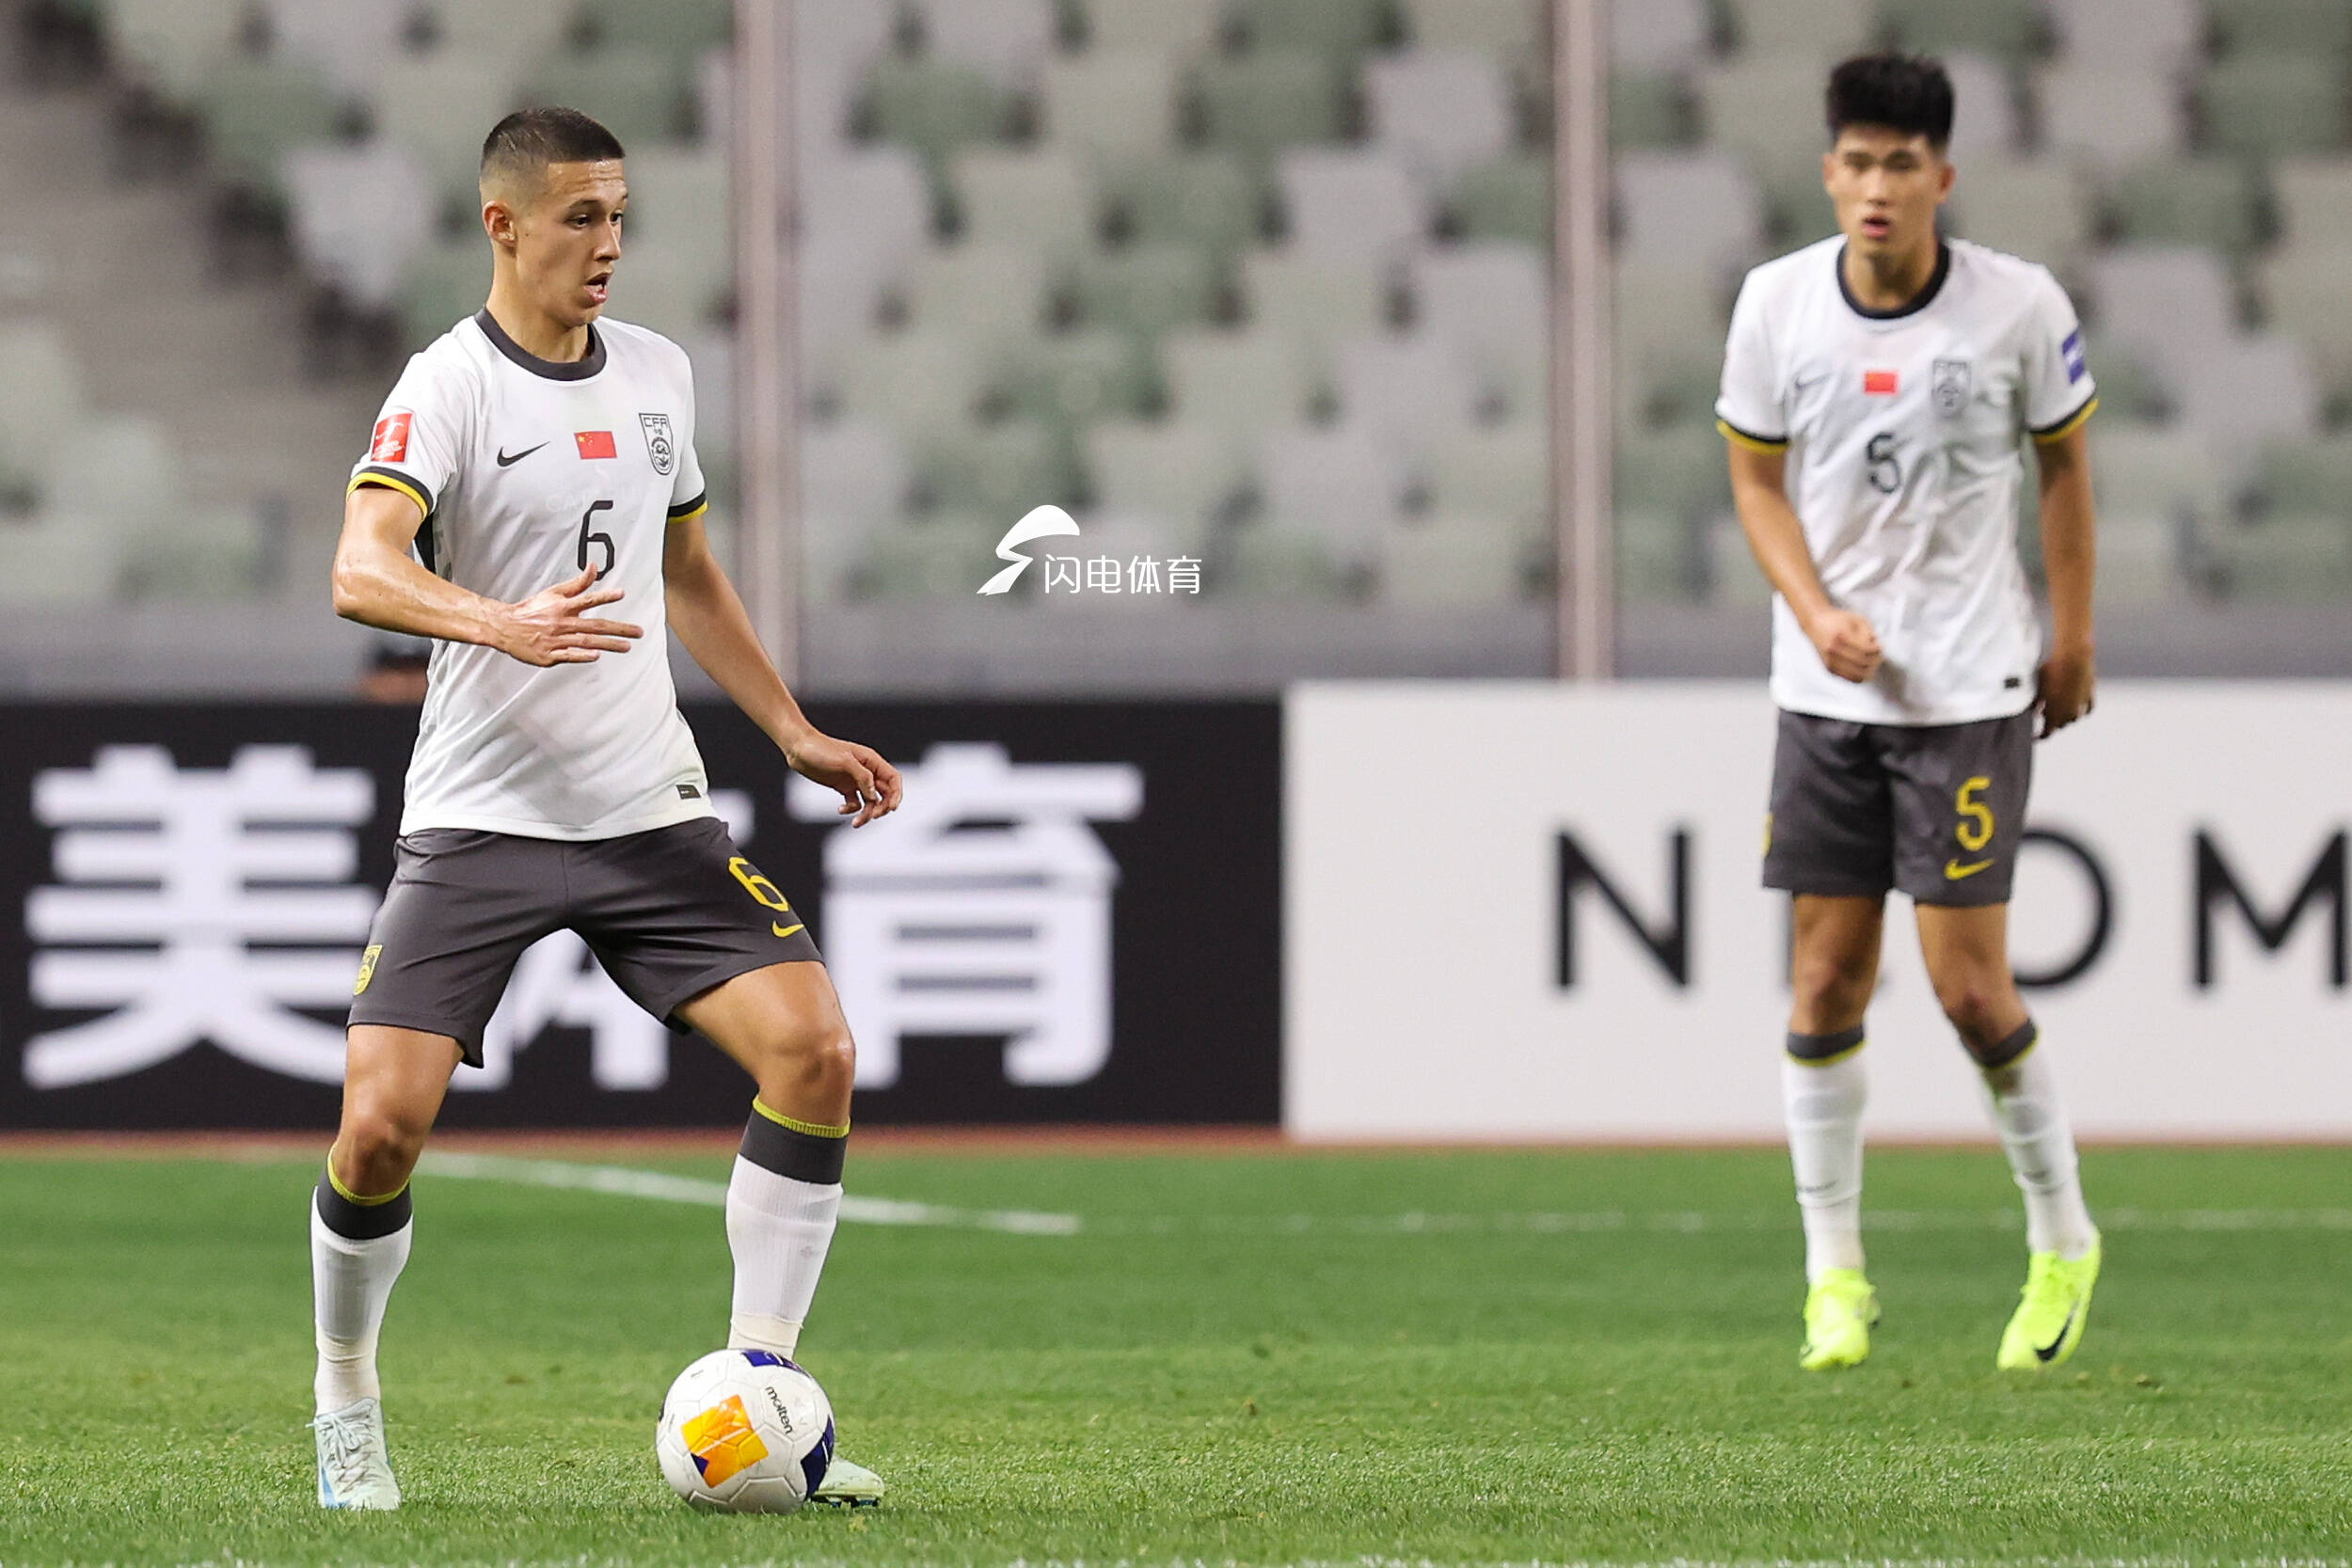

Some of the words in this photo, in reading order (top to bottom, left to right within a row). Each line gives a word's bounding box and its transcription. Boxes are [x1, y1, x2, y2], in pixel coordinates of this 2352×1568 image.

[1866, 432, 1900, 494] 5
[578, 499, 615, 581] 6
[1956, 776, 1994, 851] 5
[728, 857, 789, 912] 6
[1555, 826, 2348, 990] NOM
[764, 1386, 793, 1435] molten
